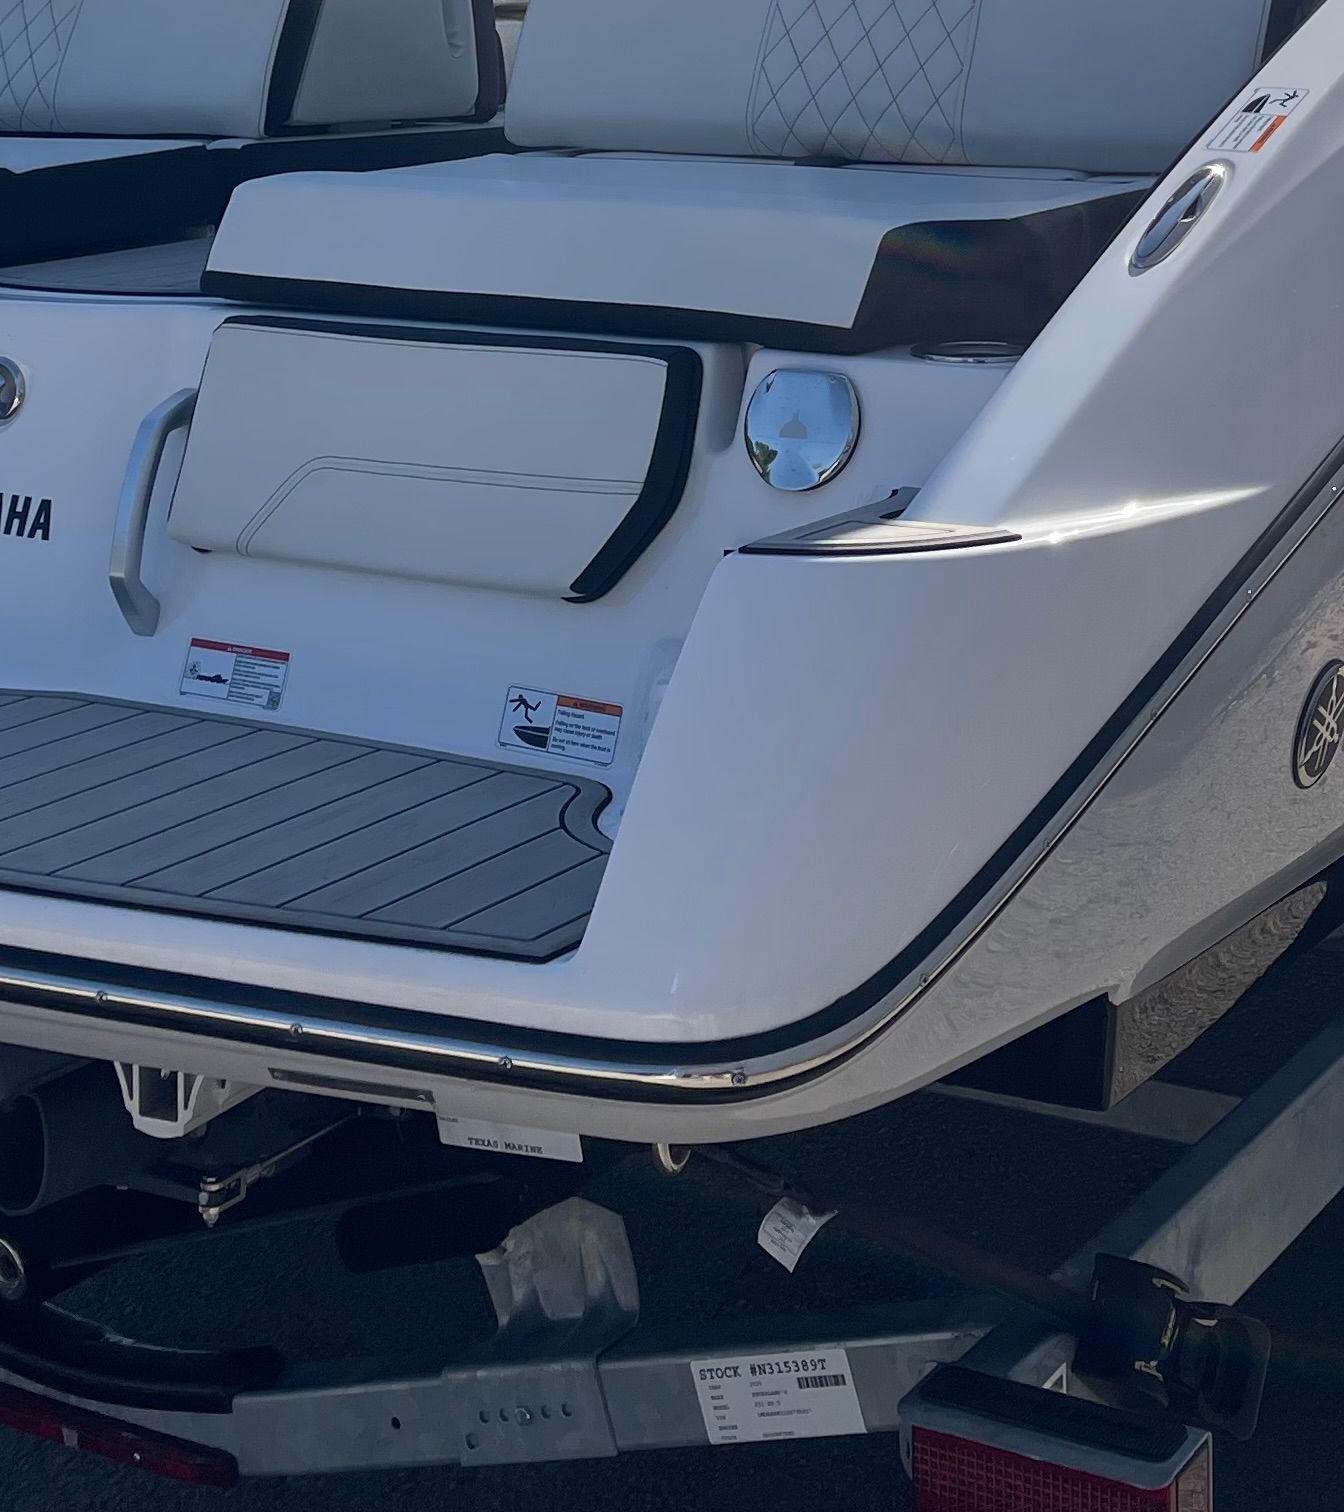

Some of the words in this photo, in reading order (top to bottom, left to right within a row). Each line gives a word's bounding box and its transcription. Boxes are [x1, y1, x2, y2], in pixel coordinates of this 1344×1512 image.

[468, 1137, 498, 1149] TEXAS
[504, 1141, 544, 1154] MARINE
[699, 1366, 742, 1381] STOCK
[749, 1359, 827, 1377] #N315389T
